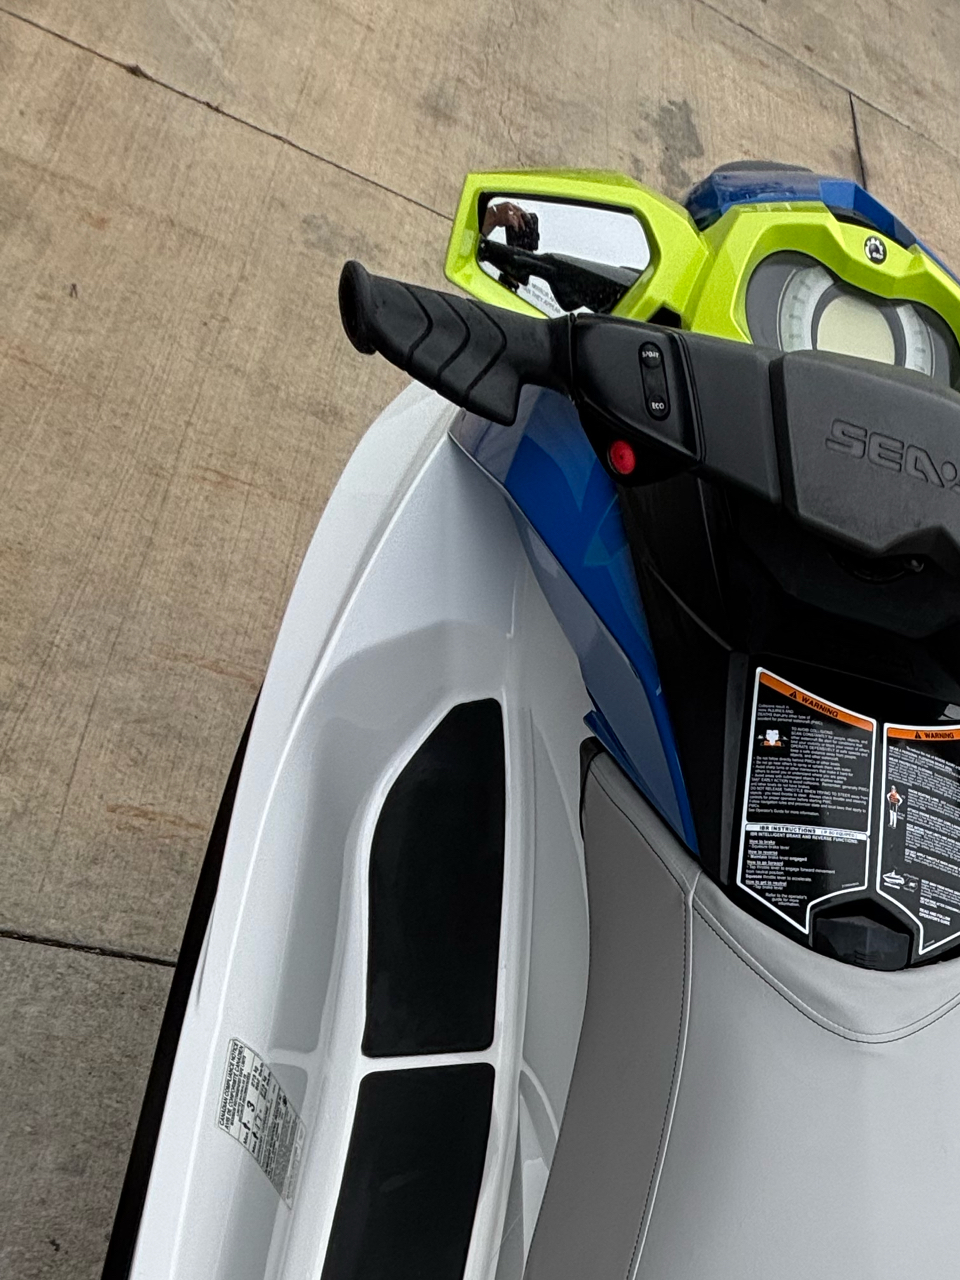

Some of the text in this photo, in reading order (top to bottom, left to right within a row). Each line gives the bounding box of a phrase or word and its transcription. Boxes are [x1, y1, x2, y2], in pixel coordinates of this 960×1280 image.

[651, 402, 665, 410] ECO
[801, 695, 839, 718] WARNING
[770, 825, 816, 834] INSTRUCTIONS
[219, 1040, 238, 1126] CANADIAN COMPLIANCE NOTICE
[246, 1098, 255, 1113] 3
